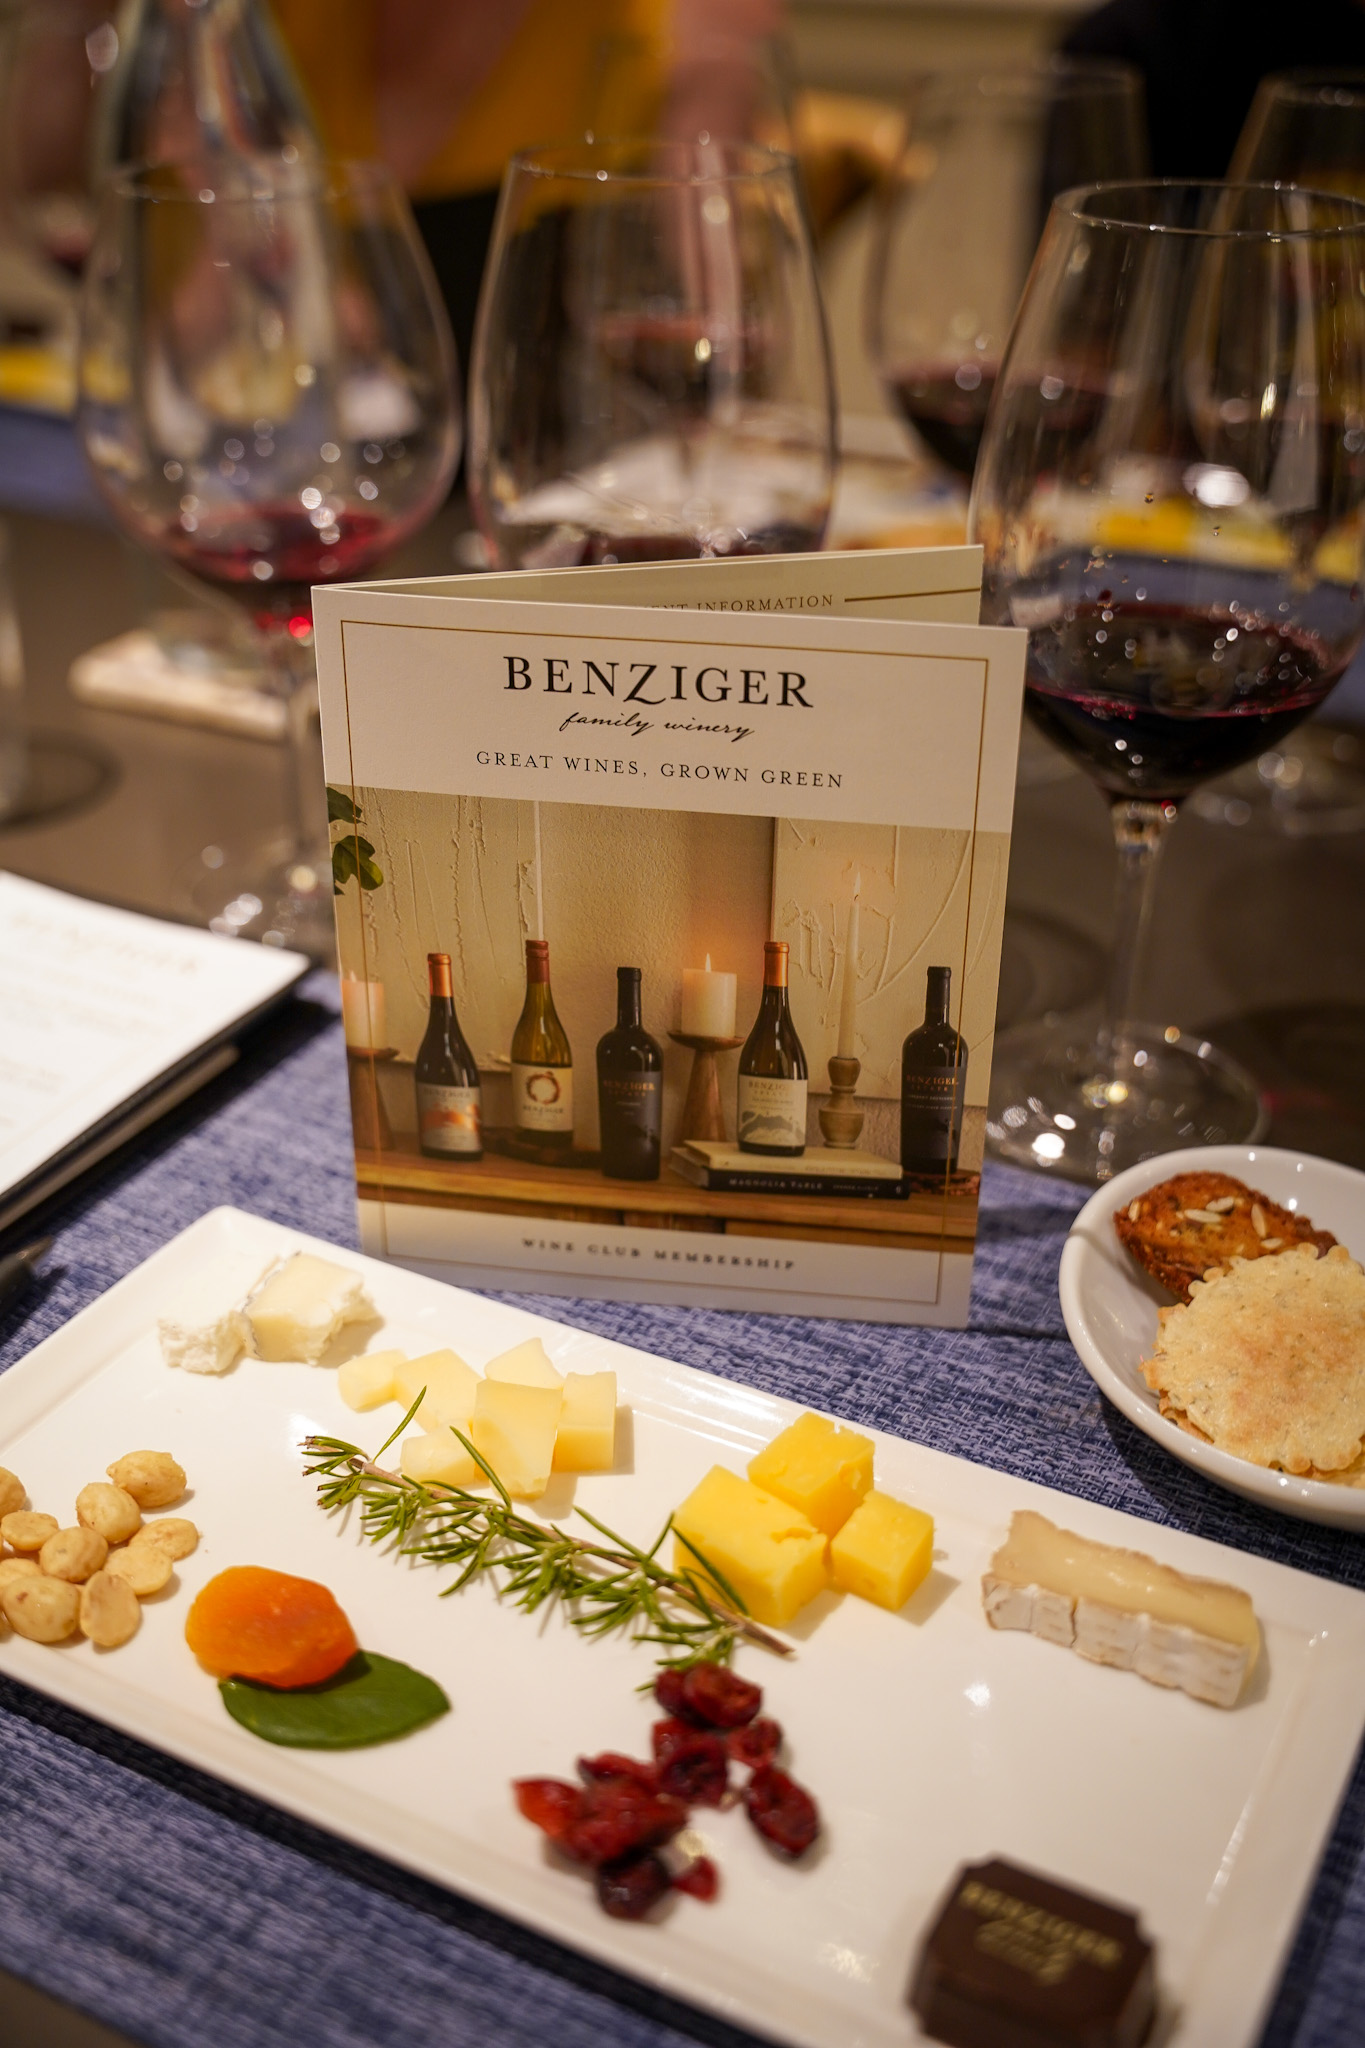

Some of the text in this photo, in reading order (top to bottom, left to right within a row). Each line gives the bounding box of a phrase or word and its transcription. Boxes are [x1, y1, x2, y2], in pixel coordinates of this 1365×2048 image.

[503, 656, 814, 708] BENZIGER
[559, 712, 755, 742] family winery
[476, 751, 843, 788] GREAT WINES, GROWN GREEN
[522, 1238, 795, 1271] WINE CLUB MEMBERSHIP
